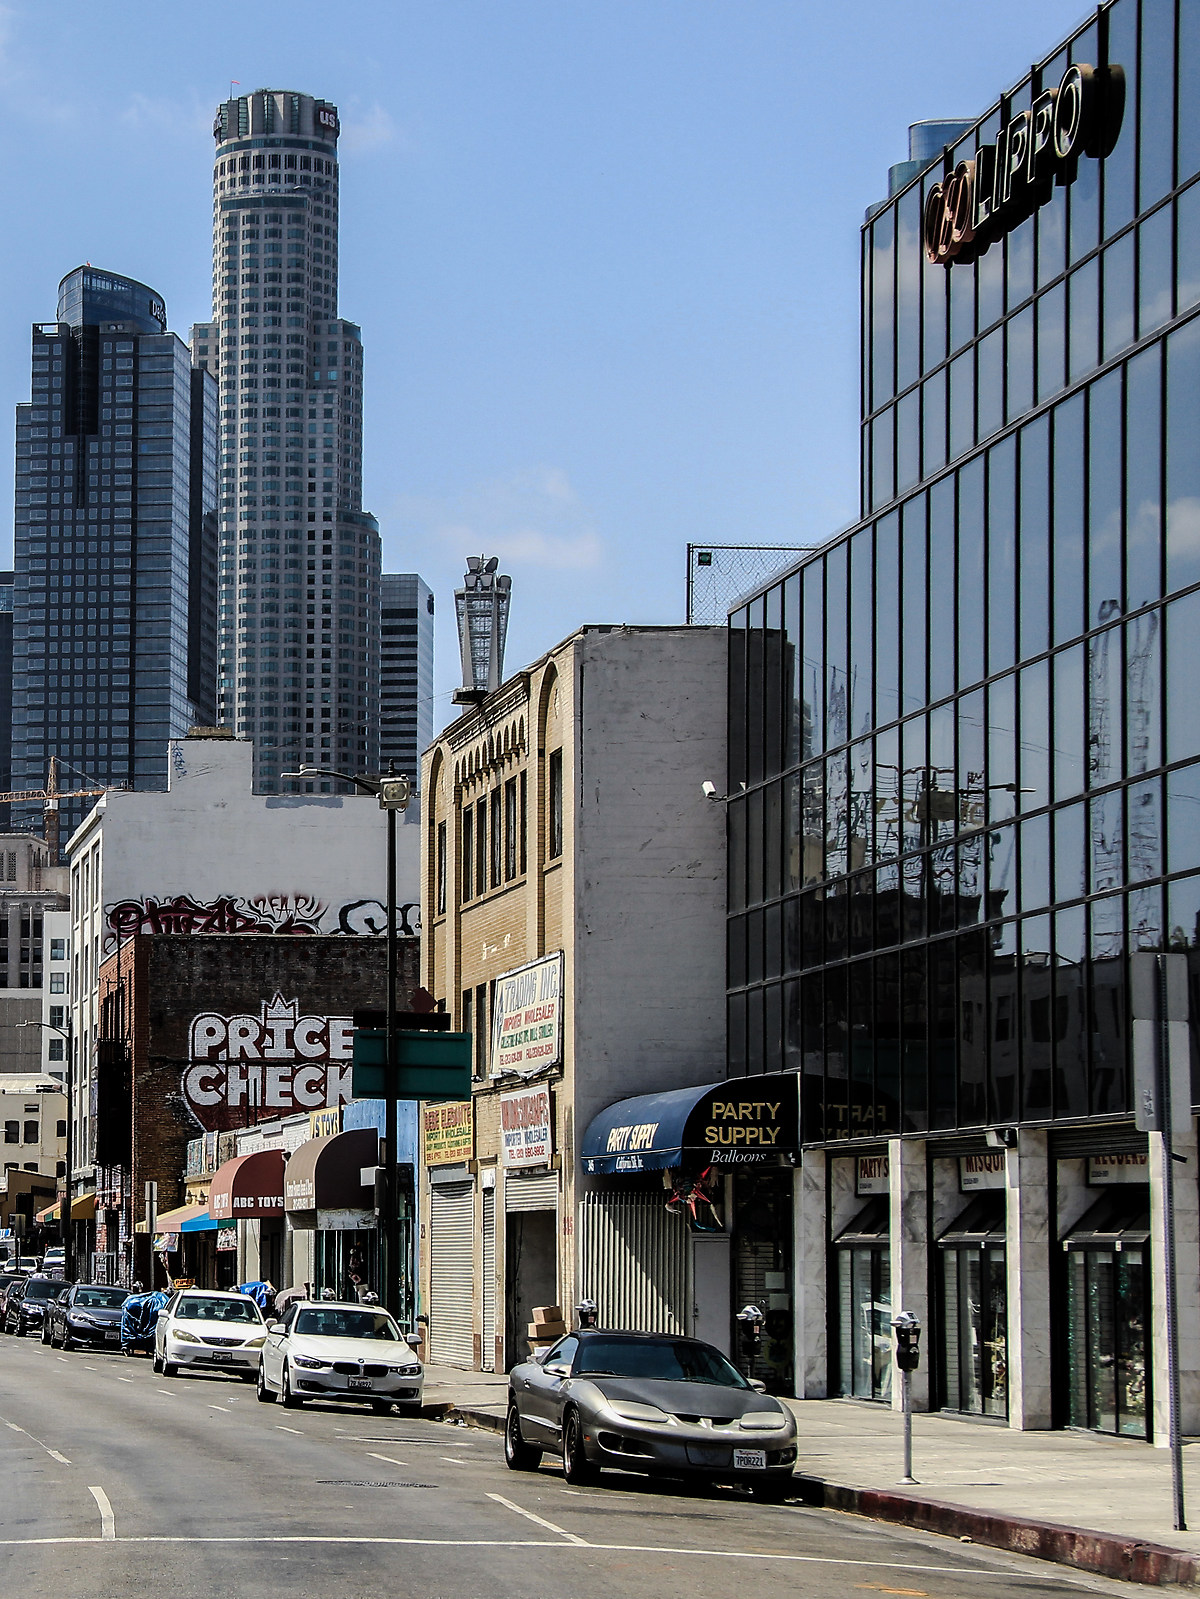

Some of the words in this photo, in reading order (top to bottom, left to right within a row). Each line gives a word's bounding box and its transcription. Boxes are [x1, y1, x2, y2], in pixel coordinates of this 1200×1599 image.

[504, 971, 537, 1014] TRADING
[539, 964, 558, 1002] INC.
[524, 1003, 555, 1025] WHOLESALER
[192, 1014, 353, 1060] PRICE
[184, 1063, 353, 1108] CHECK
[711, 1101, 781, 1121] PARTY
[446, 1126, 472, 1139] WHOLESALE
[524, 1127, 547, 1145] WHOLESALER
[606, 1125, 632, 1153] PARTY
[629, 1122, 660, 1151] SUPPLY
[704, 1125, 781, 1145] SUPPLY
[709, 1148, 767, 1164] Balloons
[860, 1157, 882, 1178] PARTY
[233, 1196, 255, 1208] ABC
[257, 1195, 284, 1208] TOYS
